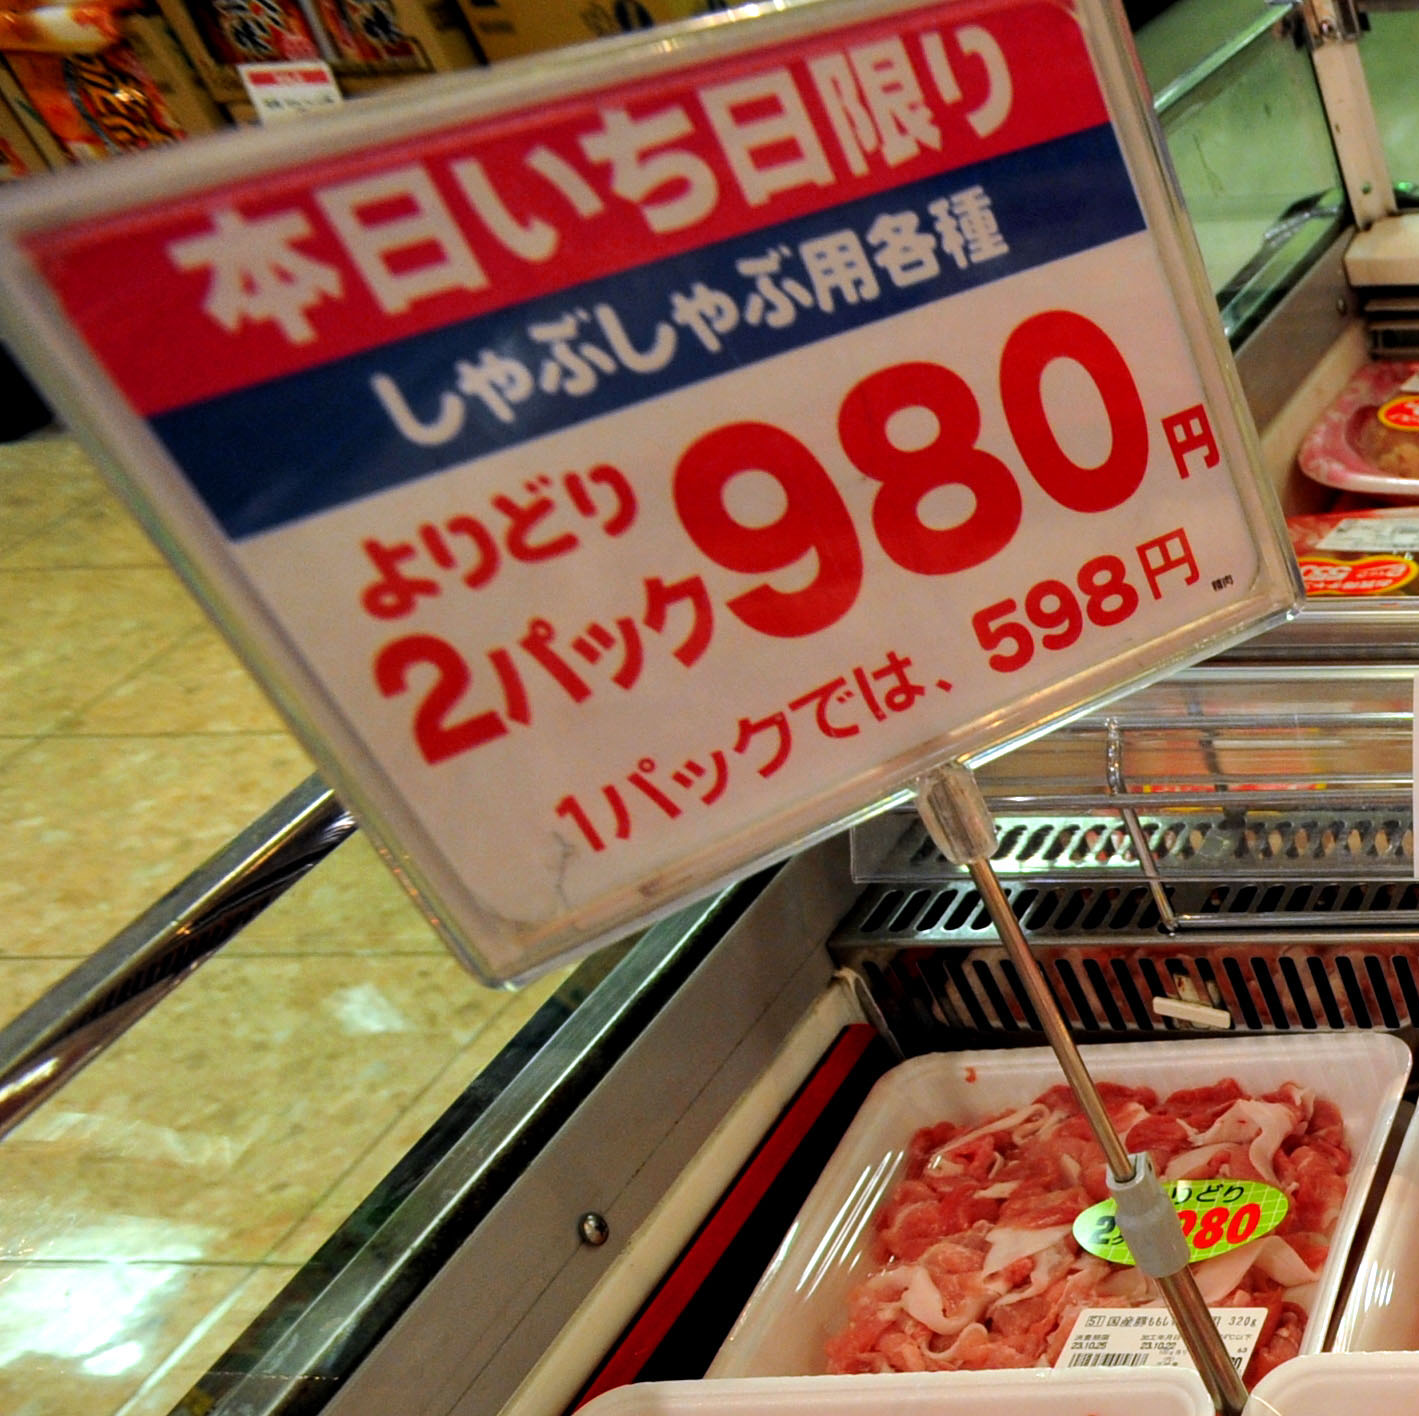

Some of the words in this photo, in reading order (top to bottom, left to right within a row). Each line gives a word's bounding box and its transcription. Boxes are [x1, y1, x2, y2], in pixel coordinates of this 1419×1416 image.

[165, 23, 1016, 349] 本日いち日限り
[369, 186, 1013, 449] しゃぶしゃぶ用各種
[356, 464, 641, 624] よりどり
[1172, 1184, 1244, 1205] りどり
